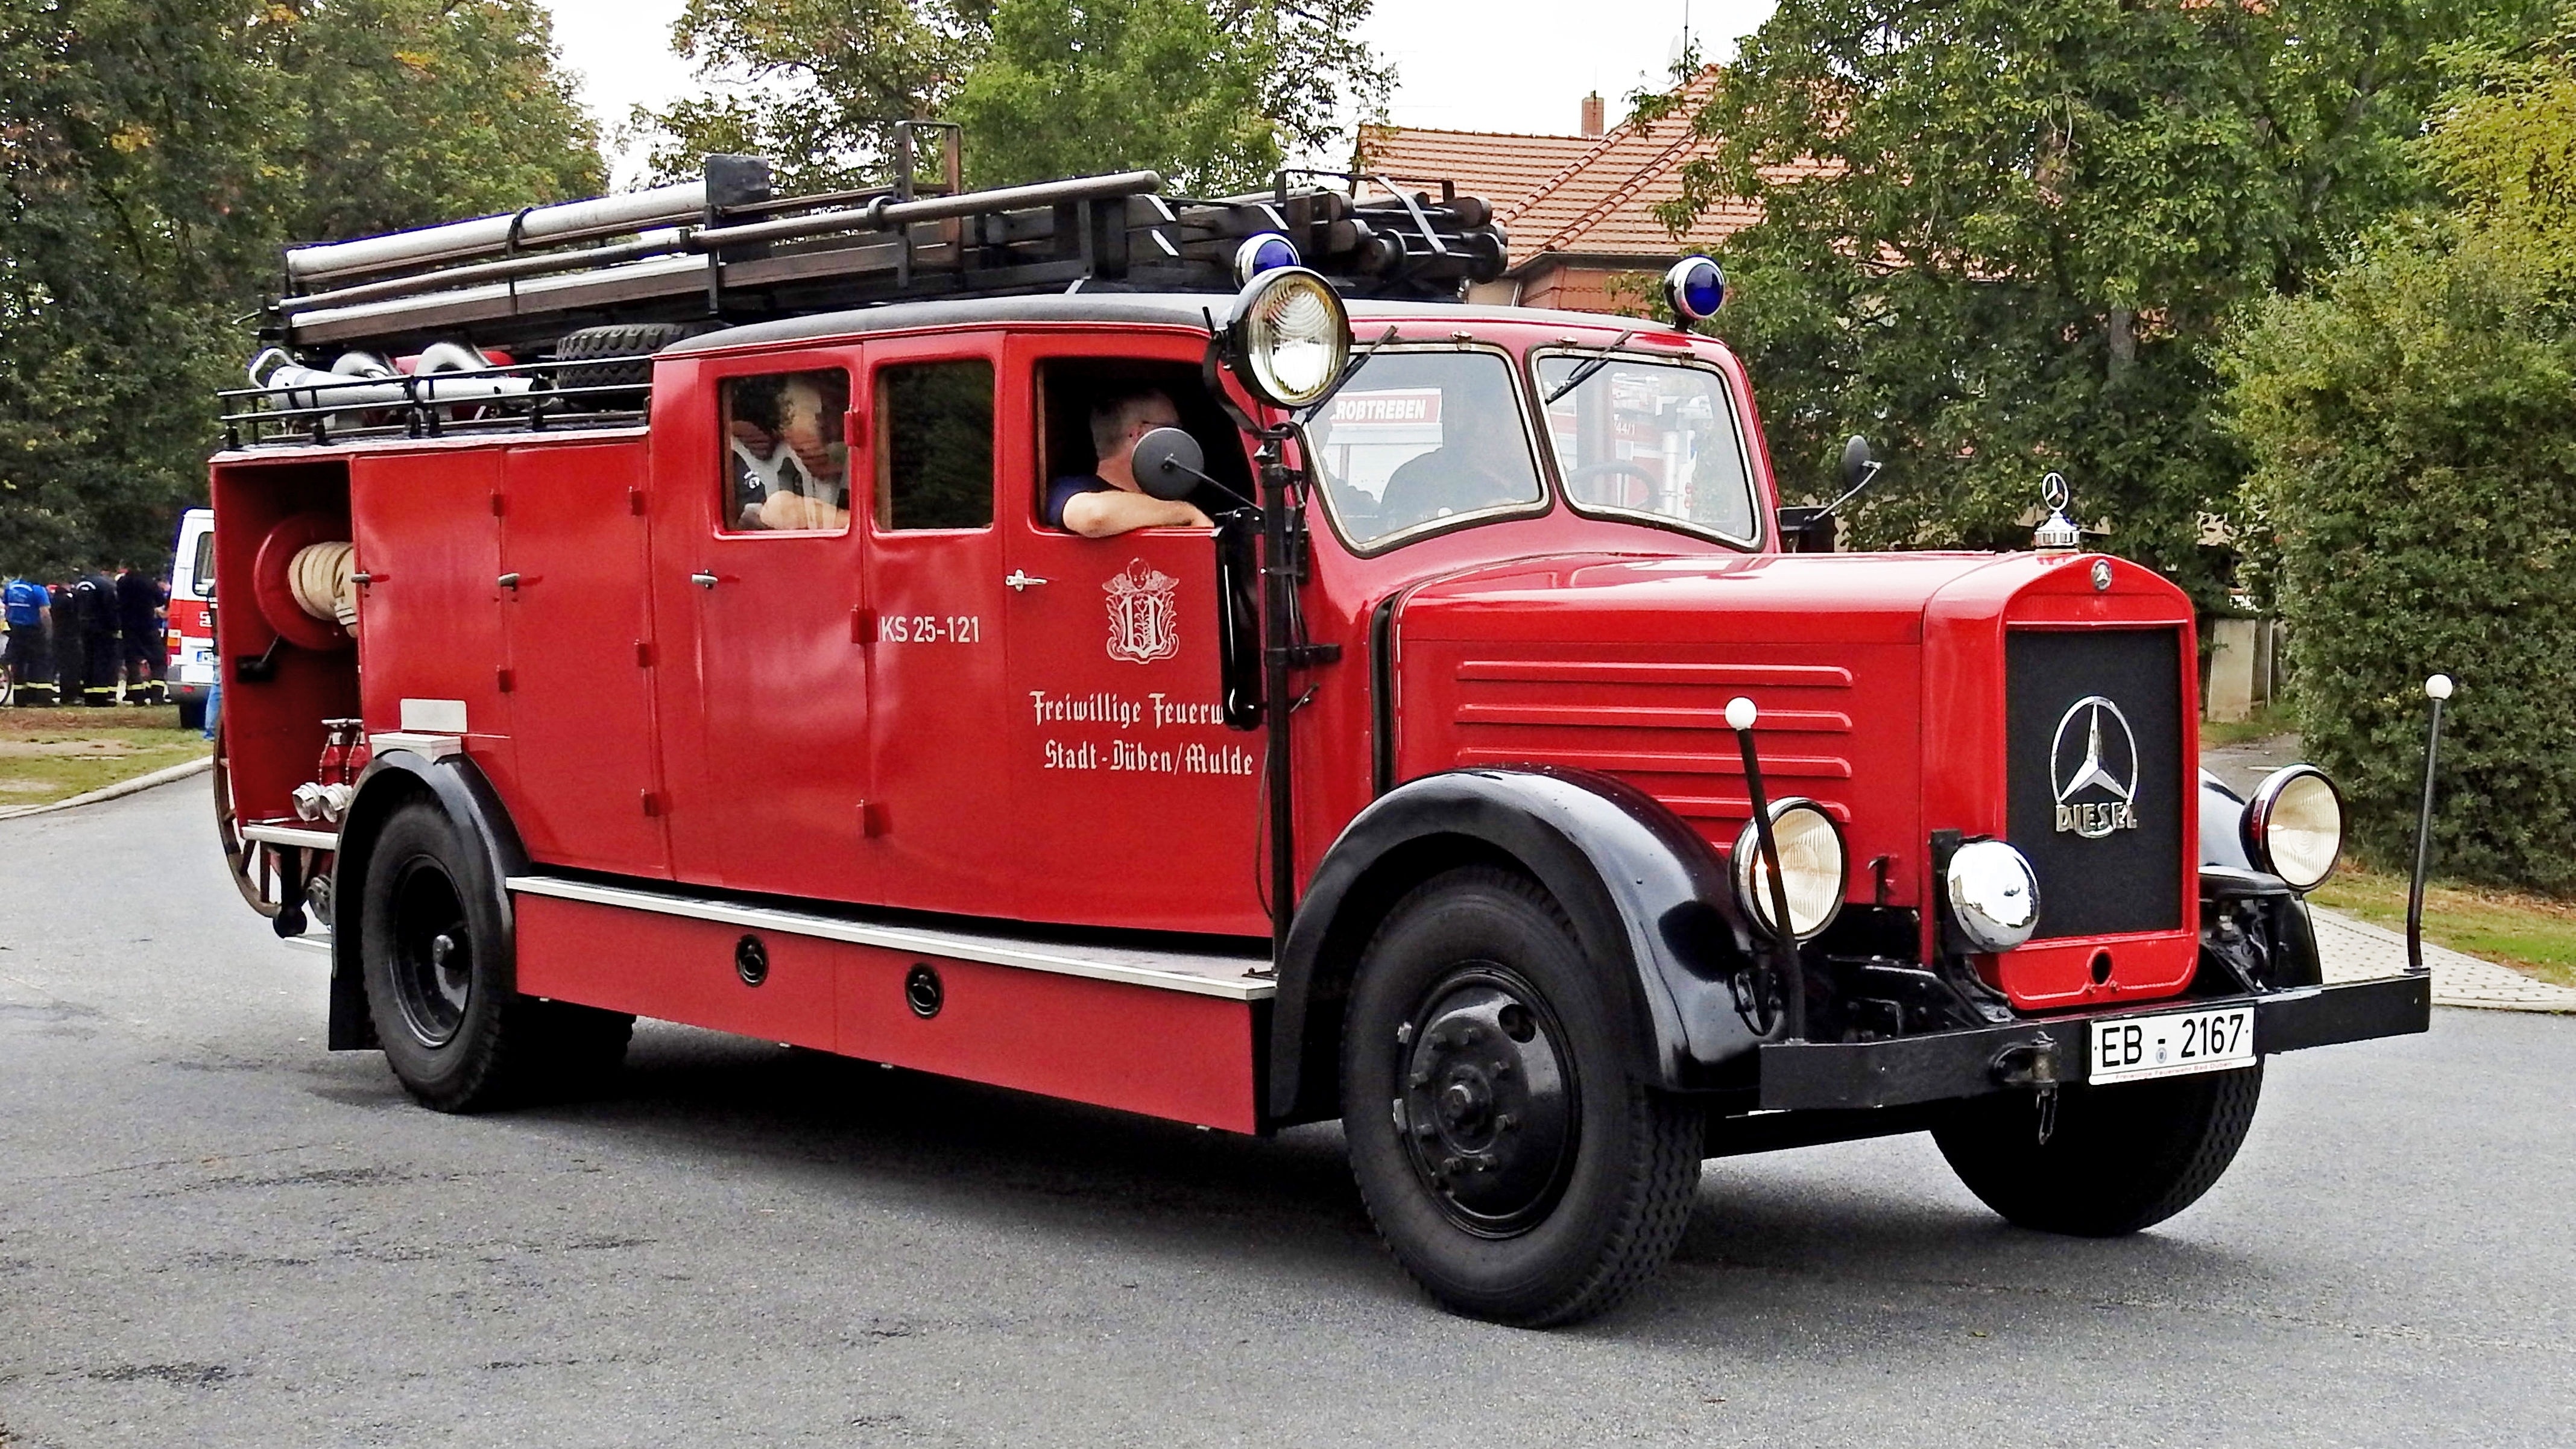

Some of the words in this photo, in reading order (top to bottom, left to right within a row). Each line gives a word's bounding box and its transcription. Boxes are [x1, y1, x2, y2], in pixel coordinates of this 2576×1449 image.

[1329, 399, 1427, 421] ROßTREBEN
[881, 616, 908, 642] KS
[913, 616, 979, 643] 25-121
[1029, 690, 1141, 729] Freiwillige
[1148, 692, 1224, 729] Feuerw
[2056, 802, 2138, 832] DIESEL
[2102, 1025, 2142, 1067] EB
[2181, 1014, 2244, 1058] 2167
